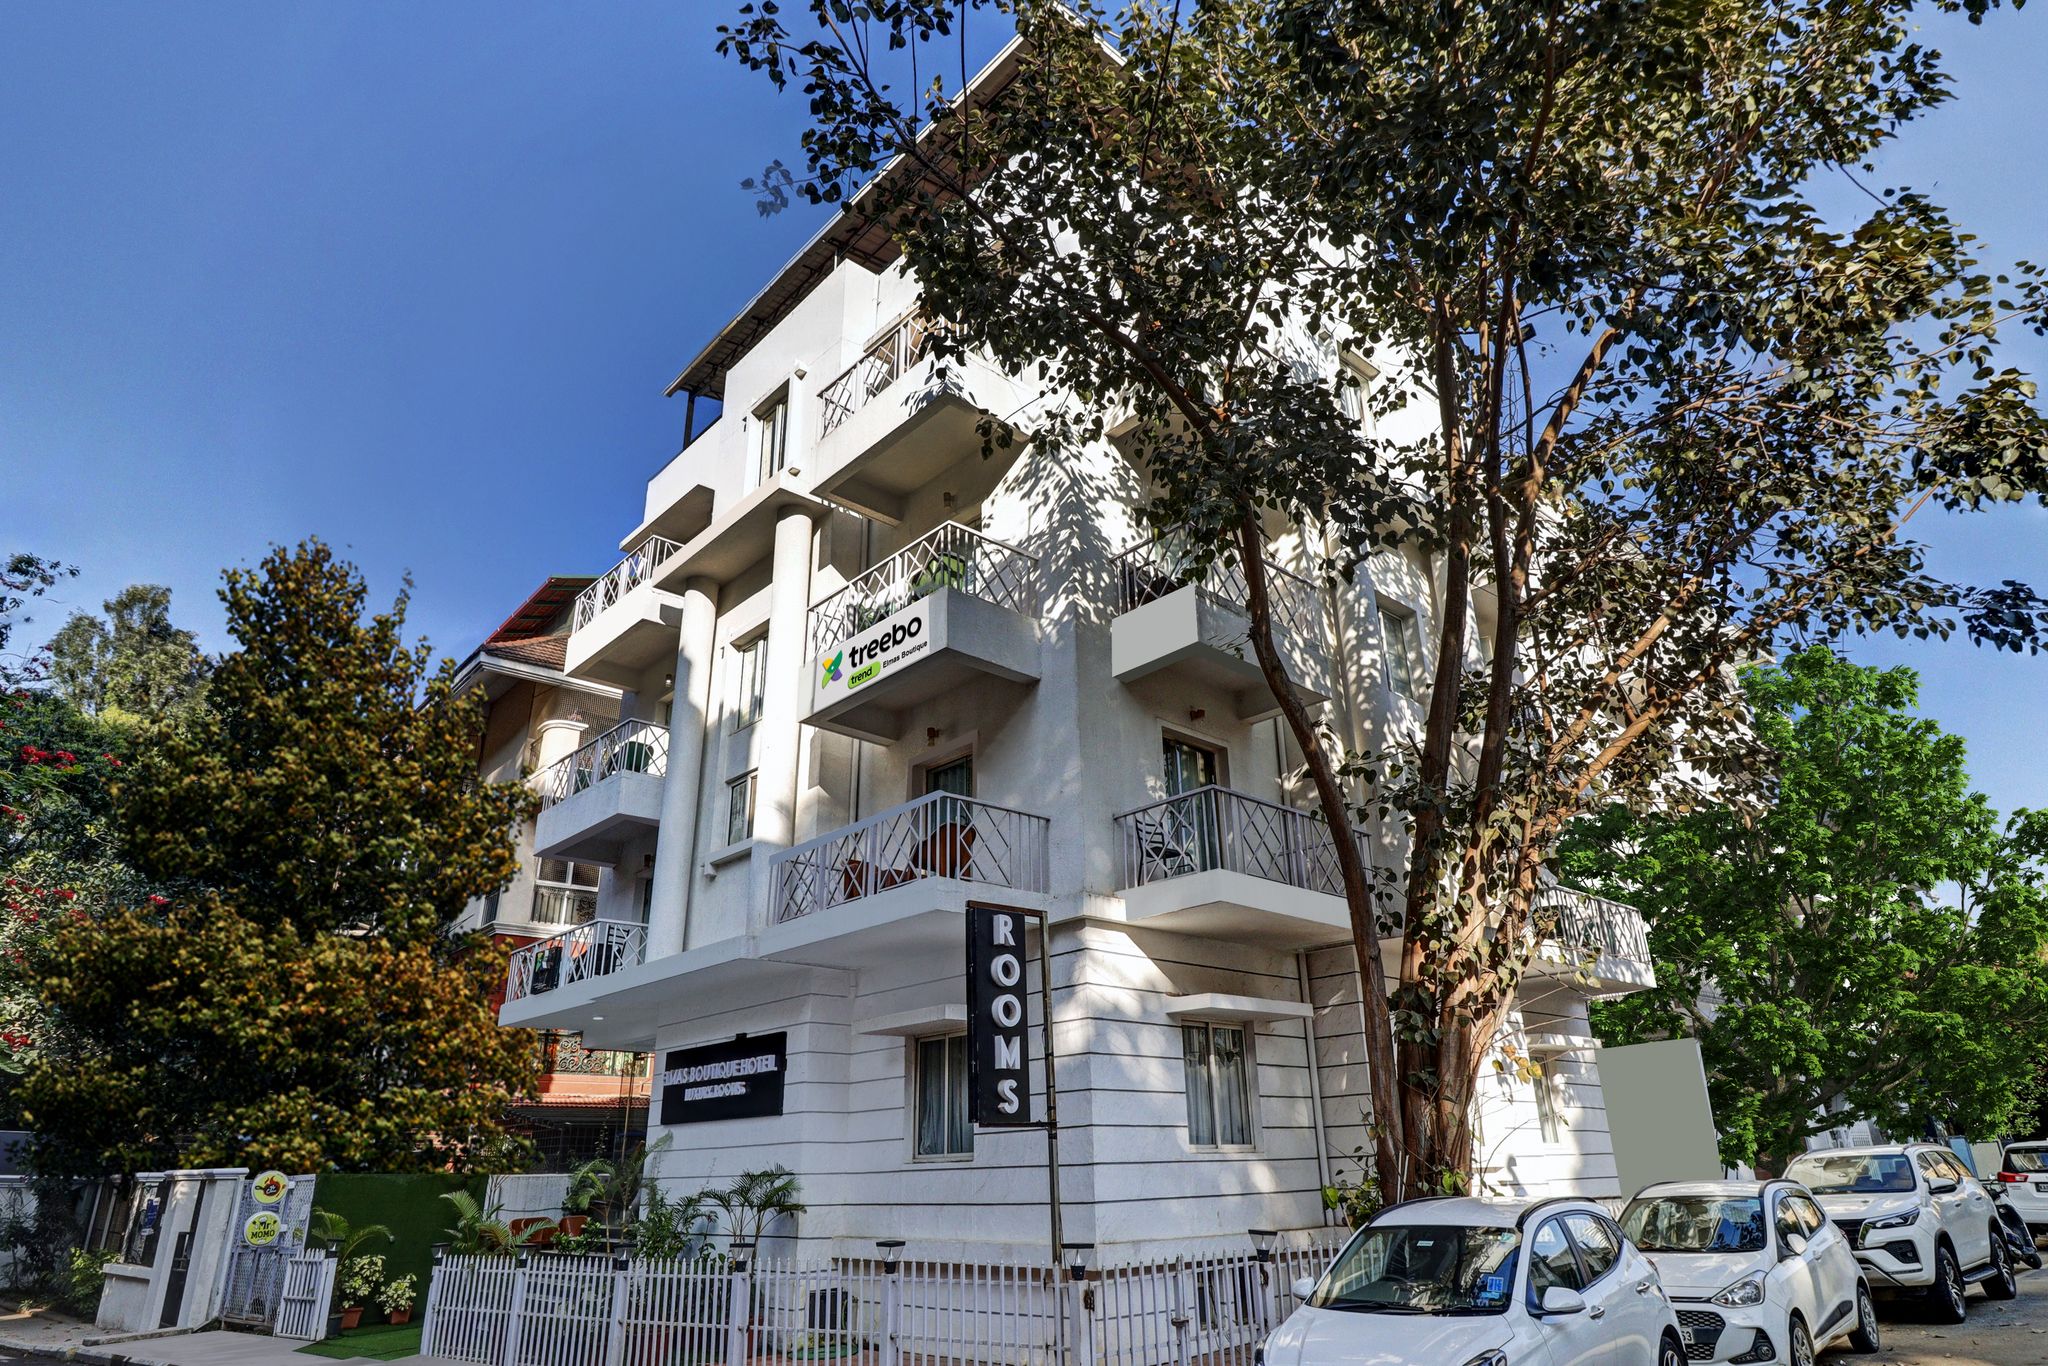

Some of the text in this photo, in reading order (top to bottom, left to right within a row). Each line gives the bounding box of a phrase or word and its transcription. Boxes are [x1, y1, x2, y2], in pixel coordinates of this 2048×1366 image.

[849, 616, 922, 668] treebo
[882, 641, 928, 669] Elmas Boutique
[851, 666, 872, 684] trend
[990, 913, 1022, 1115] ROOMS
[688, 1059, 742, 1083] BOUTIQUE
[741, 1054, 777, 1075] HOTEL
[250, 1230, 275, 1239] MOMO
